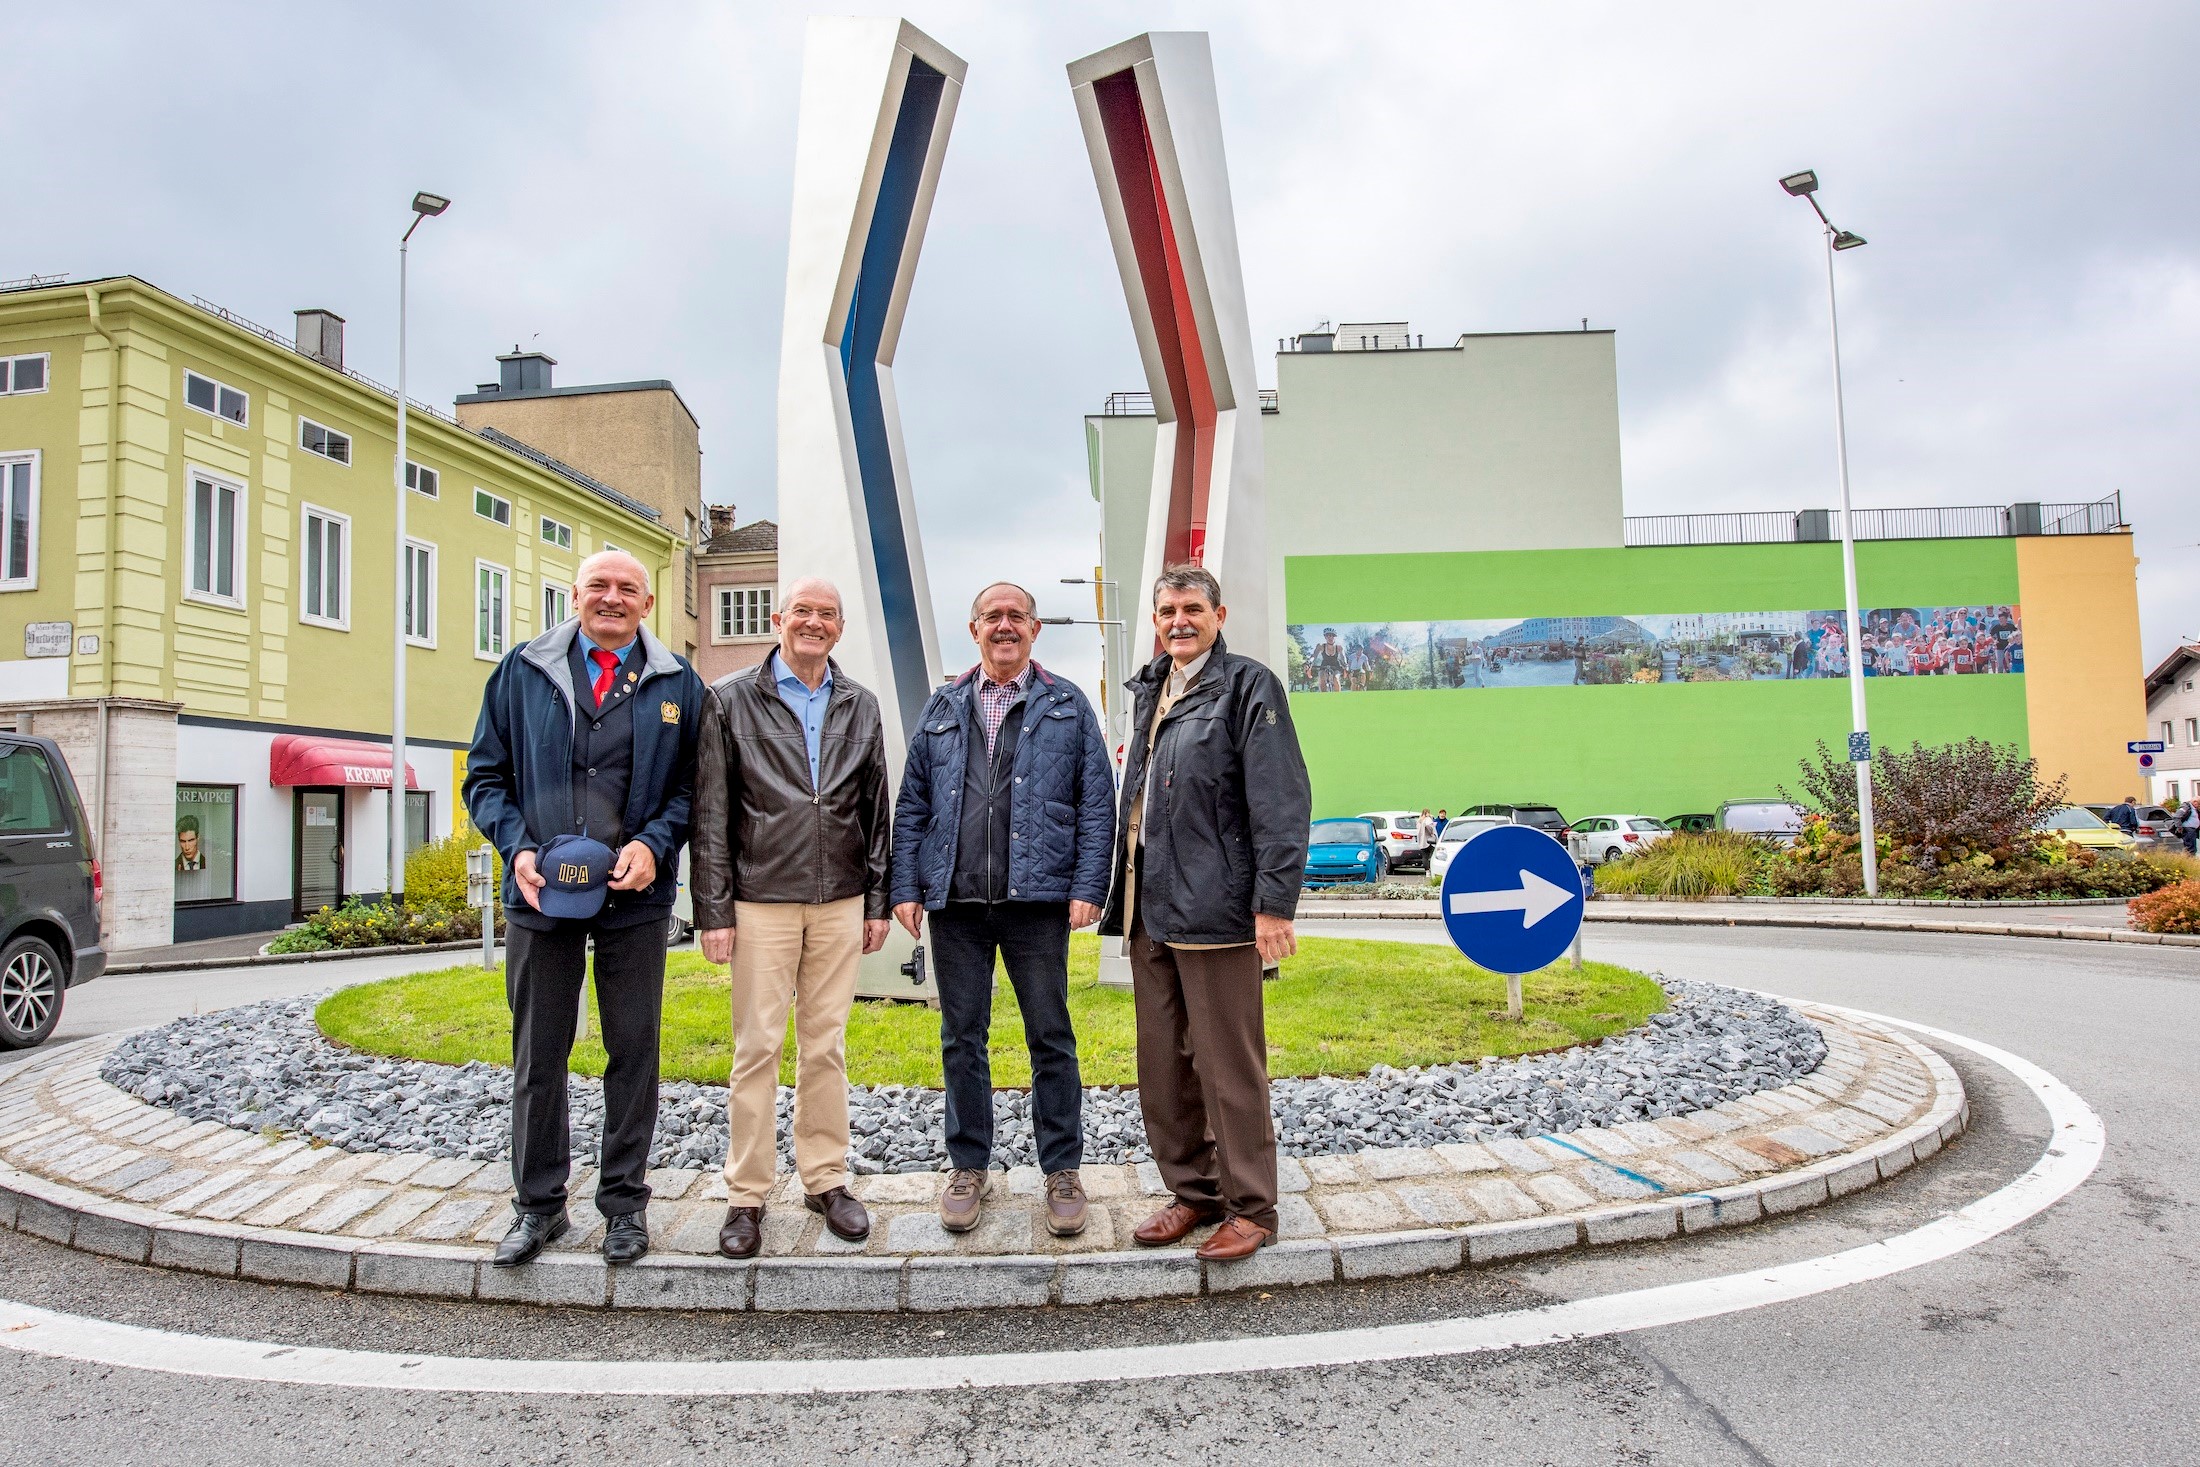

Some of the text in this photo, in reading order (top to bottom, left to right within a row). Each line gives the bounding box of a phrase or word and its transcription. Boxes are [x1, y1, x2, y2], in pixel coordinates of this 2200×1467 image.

[343, 766, 408, 785] KREMP
[176, 790, 231, 803] KREMPKE
[558, 863, 590, 884] IPA
